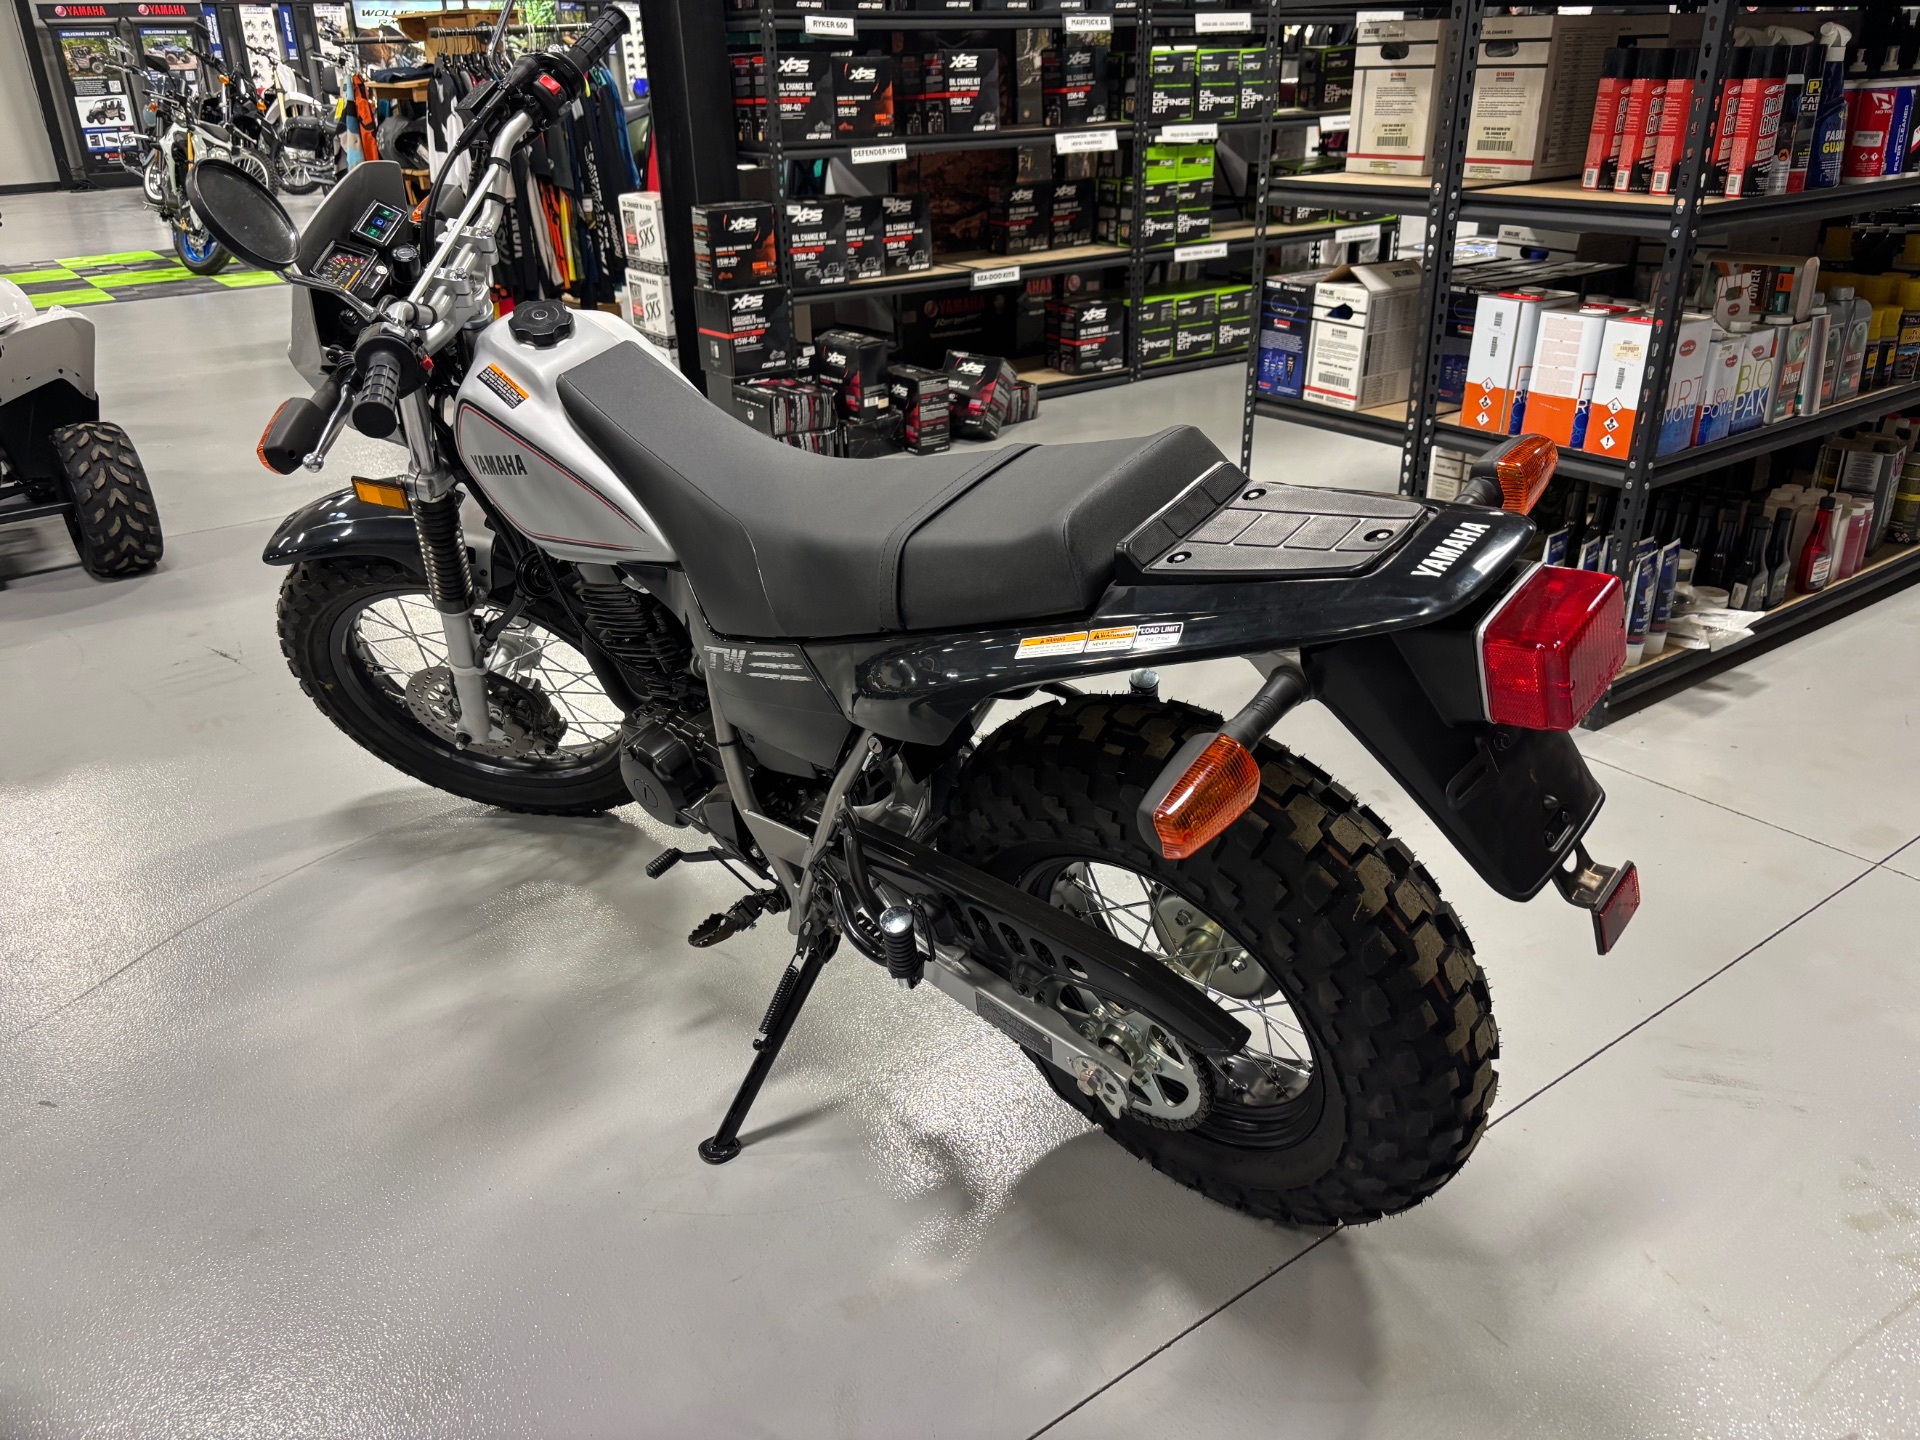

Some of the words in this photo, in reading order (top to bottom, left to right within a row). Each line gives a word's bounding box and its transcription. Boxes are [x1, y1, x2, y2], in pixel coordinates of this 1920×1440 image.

[66, 6, 106, 16] YAMAHA
[149, 4, 186, 15] YAMAHA
[813, 20, 834, 28] RYKER
[778, 57, 810, 72] XPS
[949, 54, 979, 68] XPS
[1066, 51, 1092, 66] XPS
[849, 67, 877, 80] XPS
[786, 82, 805, 91] CHANGE
[806, 82, 814, 90] KIT
[1152, 98, 1190, 106] CHANGE
[1200, 96, 1234, 104] CHANGE
[1894, 145, 1902, 172] FILTER
[1898, 105, 1910, 144] CLEANER
[853, 148, 888, 158] DEFENDER
[888, 147, 904, 156] HD11
[1010, 188, 1034, 202] XPS
[1054, 184, 1078, 198] XPS
[886, 199, 912, 214] XPS
[792, 208, 824, 224] XPS
[728, 216, 758, 231] XPS
[893, 223, 908, 232] CHANGE
[1178, 218, 1210, 228] CHANGE
[1178, 226, 1190, 234] KIT
[638, 225, 655, 250] SXS
[801, 233, 819, 242] CHANGE
[977, 273, 1002, 282] SEA-DOO
[732, 294, 764, 310] XPS
[646, 299, 661, 321] SXS
[1080, 307, 1108, 322] XPS
[1088, 326, 1102, 336] CHANGE
[1178, 333, 1212, 345] CHANGE
[1177, 343, 1191, 351] KIT
[762, 360, 786, 368] can-am
[827, 352, 846, 365] XPS
[958, 362, 986, 374] XPS
[502, 375, 519, 390] WARNING
[1736, 360, 1773, 395] BIO
[1782, 370, 1801, 386] POWER
[890, 384, 908, 397] XPS
[1666, 376, 1703, 409] IRT
[1731, 387, 1770, 421] PAK
[470, 454, 528, 476] YAMAHA
[1410, 522, 1490, 578] YAMAHA
[1140, 626, 1160, 634] LOAD
[1160, 626, 1180, 634] LIMIT
